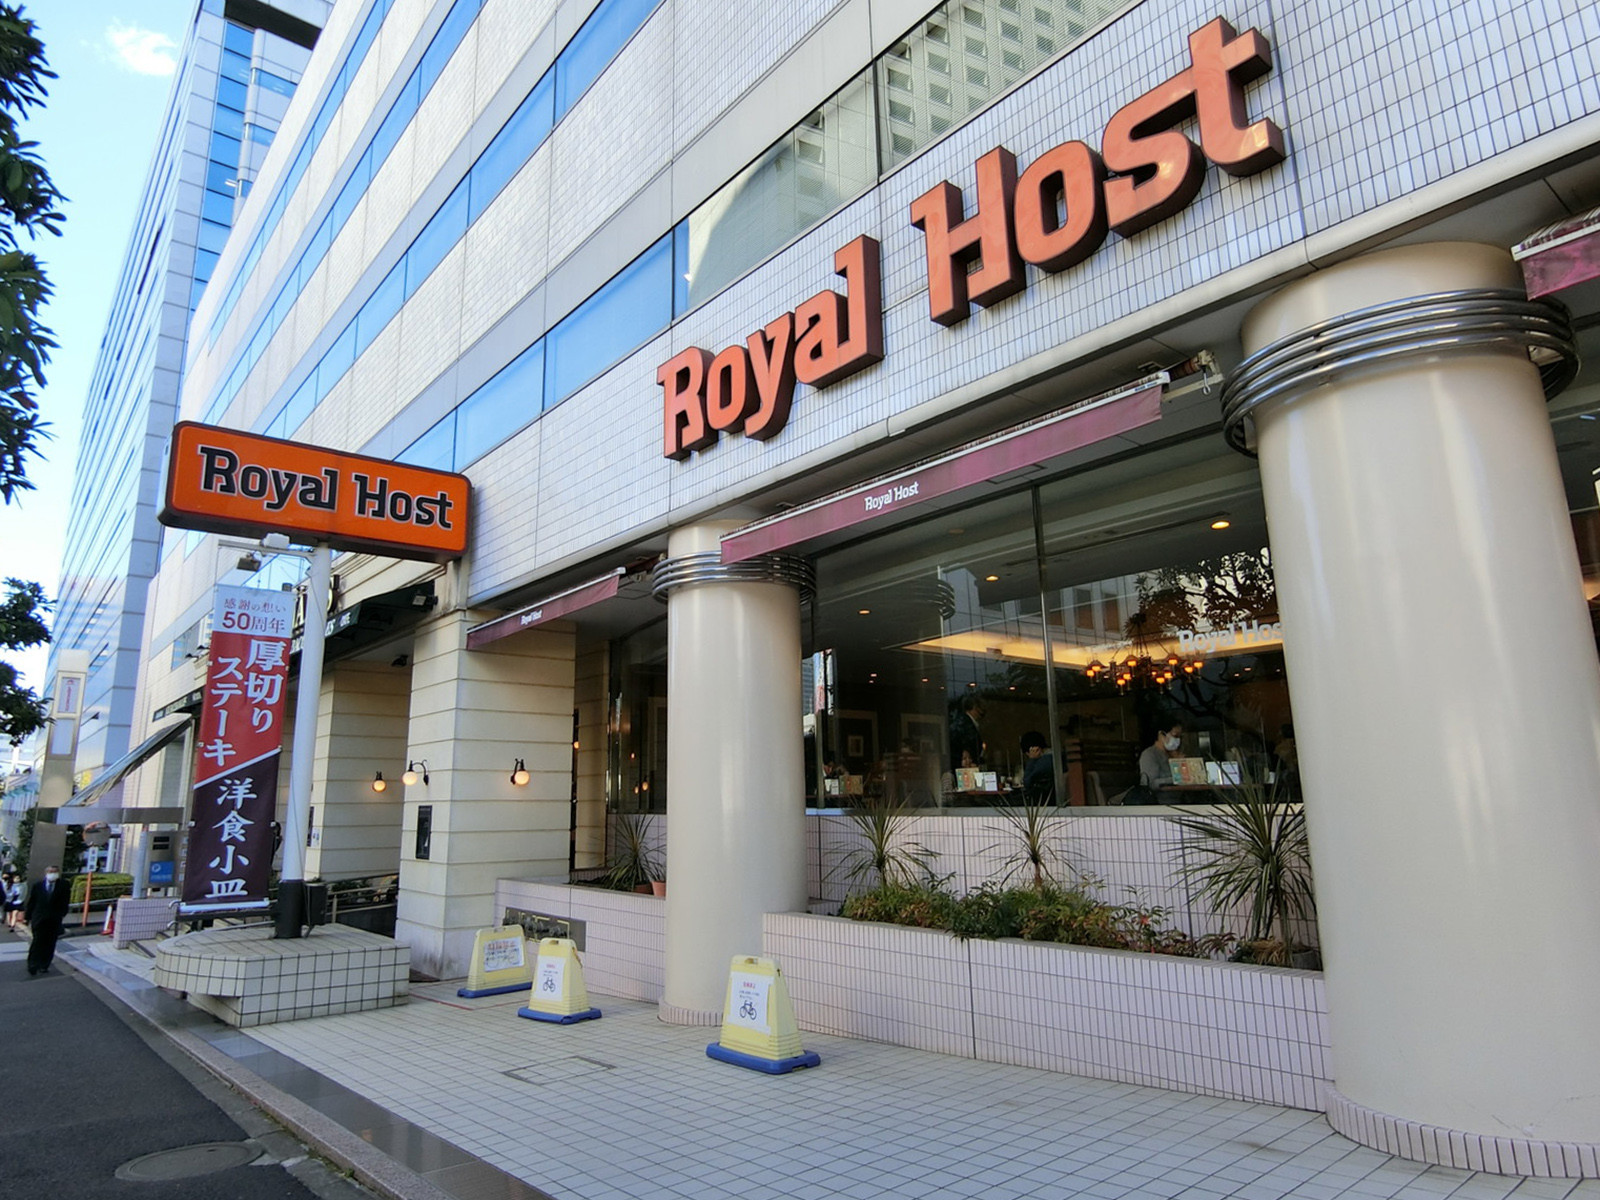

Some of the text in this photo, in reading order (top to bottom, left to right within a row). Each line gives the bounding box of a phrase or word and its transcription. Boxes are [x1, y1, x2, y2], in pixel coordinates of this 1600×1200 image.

[657, 15, 1286, 461] Royal Host
[197, 444, 453, 531] Royal Host
[865, 482, 918, 511] Royal Host
[222, 611, 286, 634] 50周年
[223, 597, 287, 614] 感謝の想い
[1177, 622, 1236, 653] Royal
[203, 656, 243, 767] ステーキ
[244, 638, 287, 734] 厚切り
[205, 777, 258, 899] 洋食小皿
